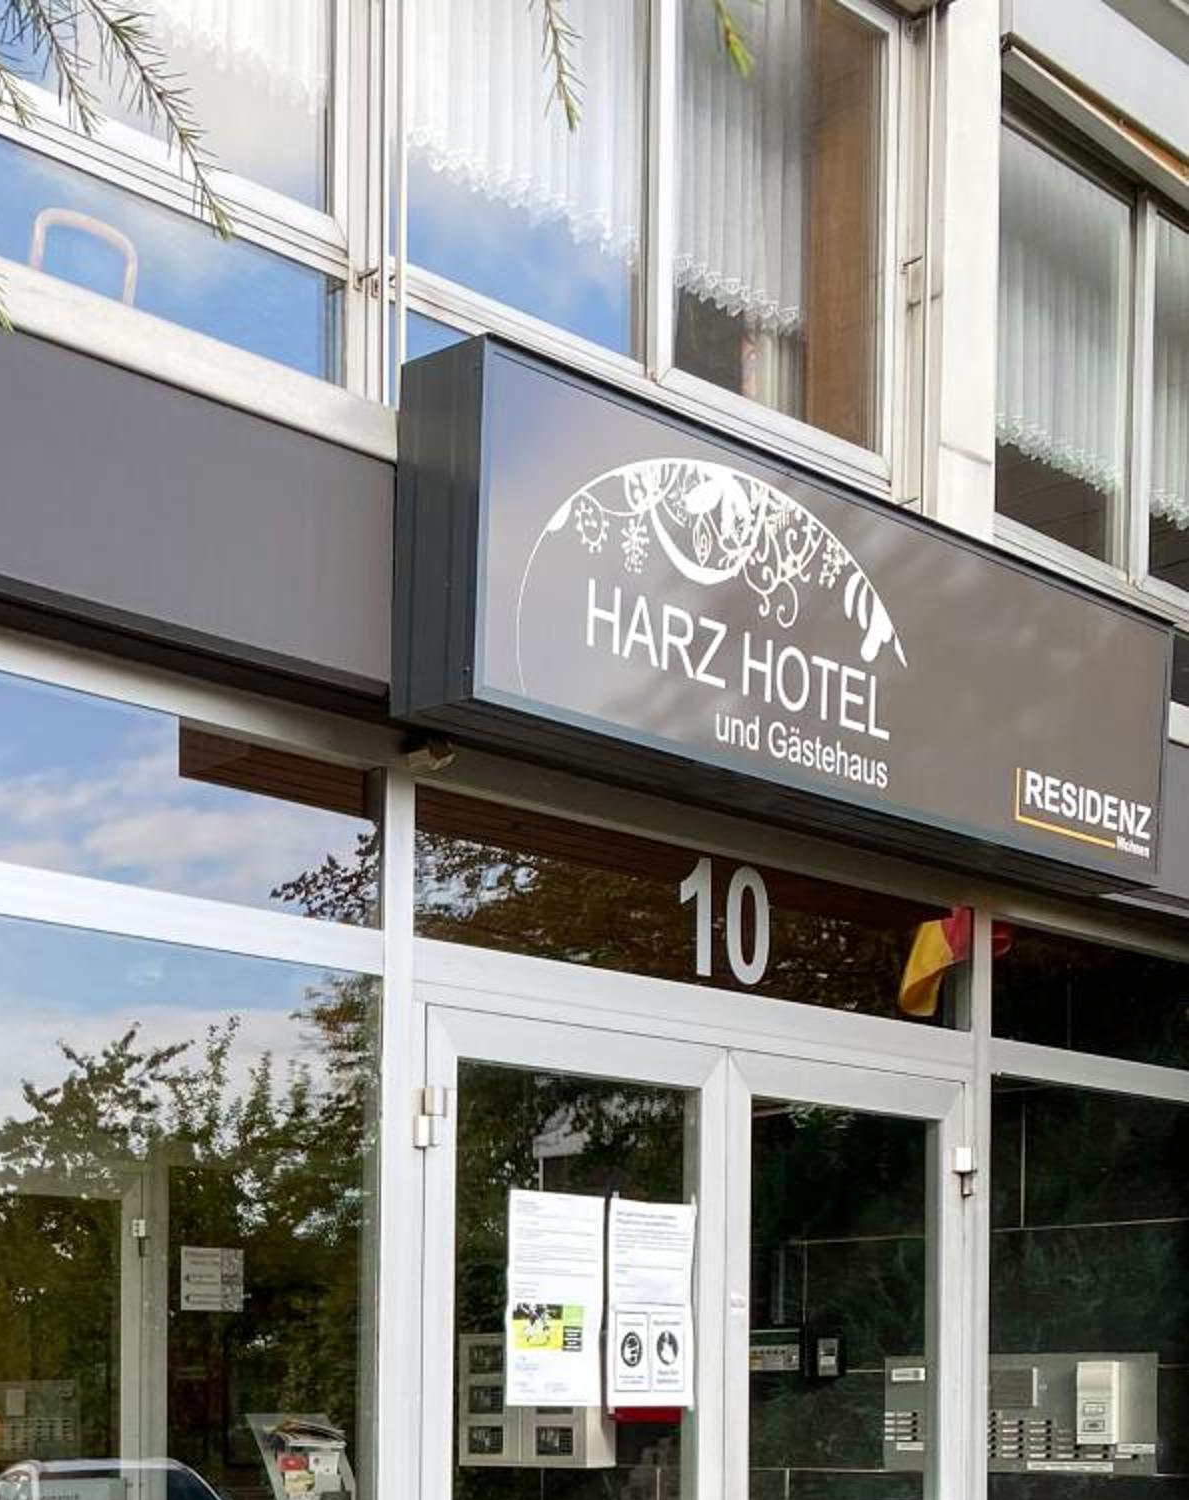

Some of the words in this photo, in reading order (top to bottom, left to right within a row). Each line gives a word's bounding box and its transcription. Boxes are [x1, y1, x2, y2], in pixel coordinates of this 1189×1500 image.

[586, 578, 728, 689] HARZ
[742, 631, 890, 741] HOTEL
[715, 712, 760, 751] und
[768, 721, 889, 789] Gästehaus
[1024, 769, 1152, 840] RESIDENZ
[680, 857, 770, 986] 10
